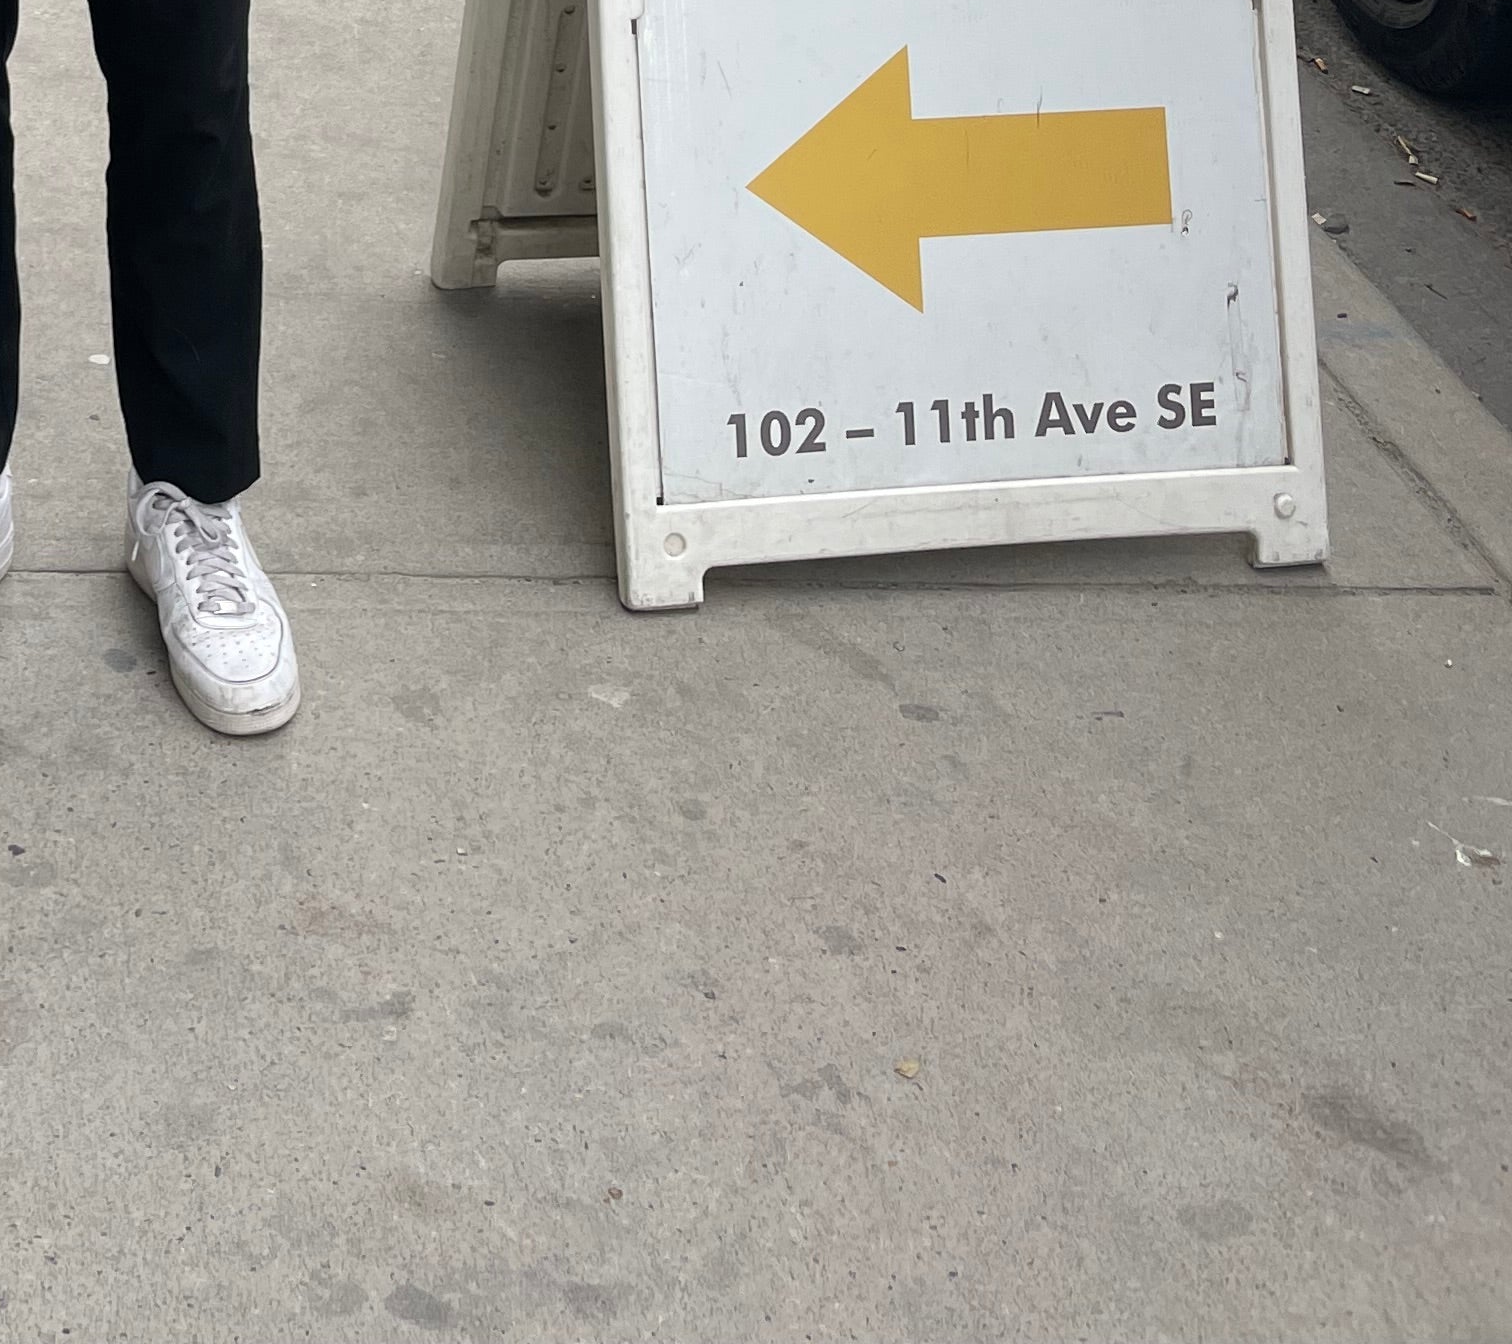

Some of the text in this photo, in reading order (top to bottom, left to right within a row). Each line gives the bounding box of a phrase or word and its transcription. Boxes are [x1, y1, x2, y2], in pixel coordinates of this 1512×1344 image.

[726, 407, 827, 459] 102
[895, 393, 1016, 446] 11th
[1034, 391, 1137, 438] Ave
[1156, 381, 1218, 431] SE
